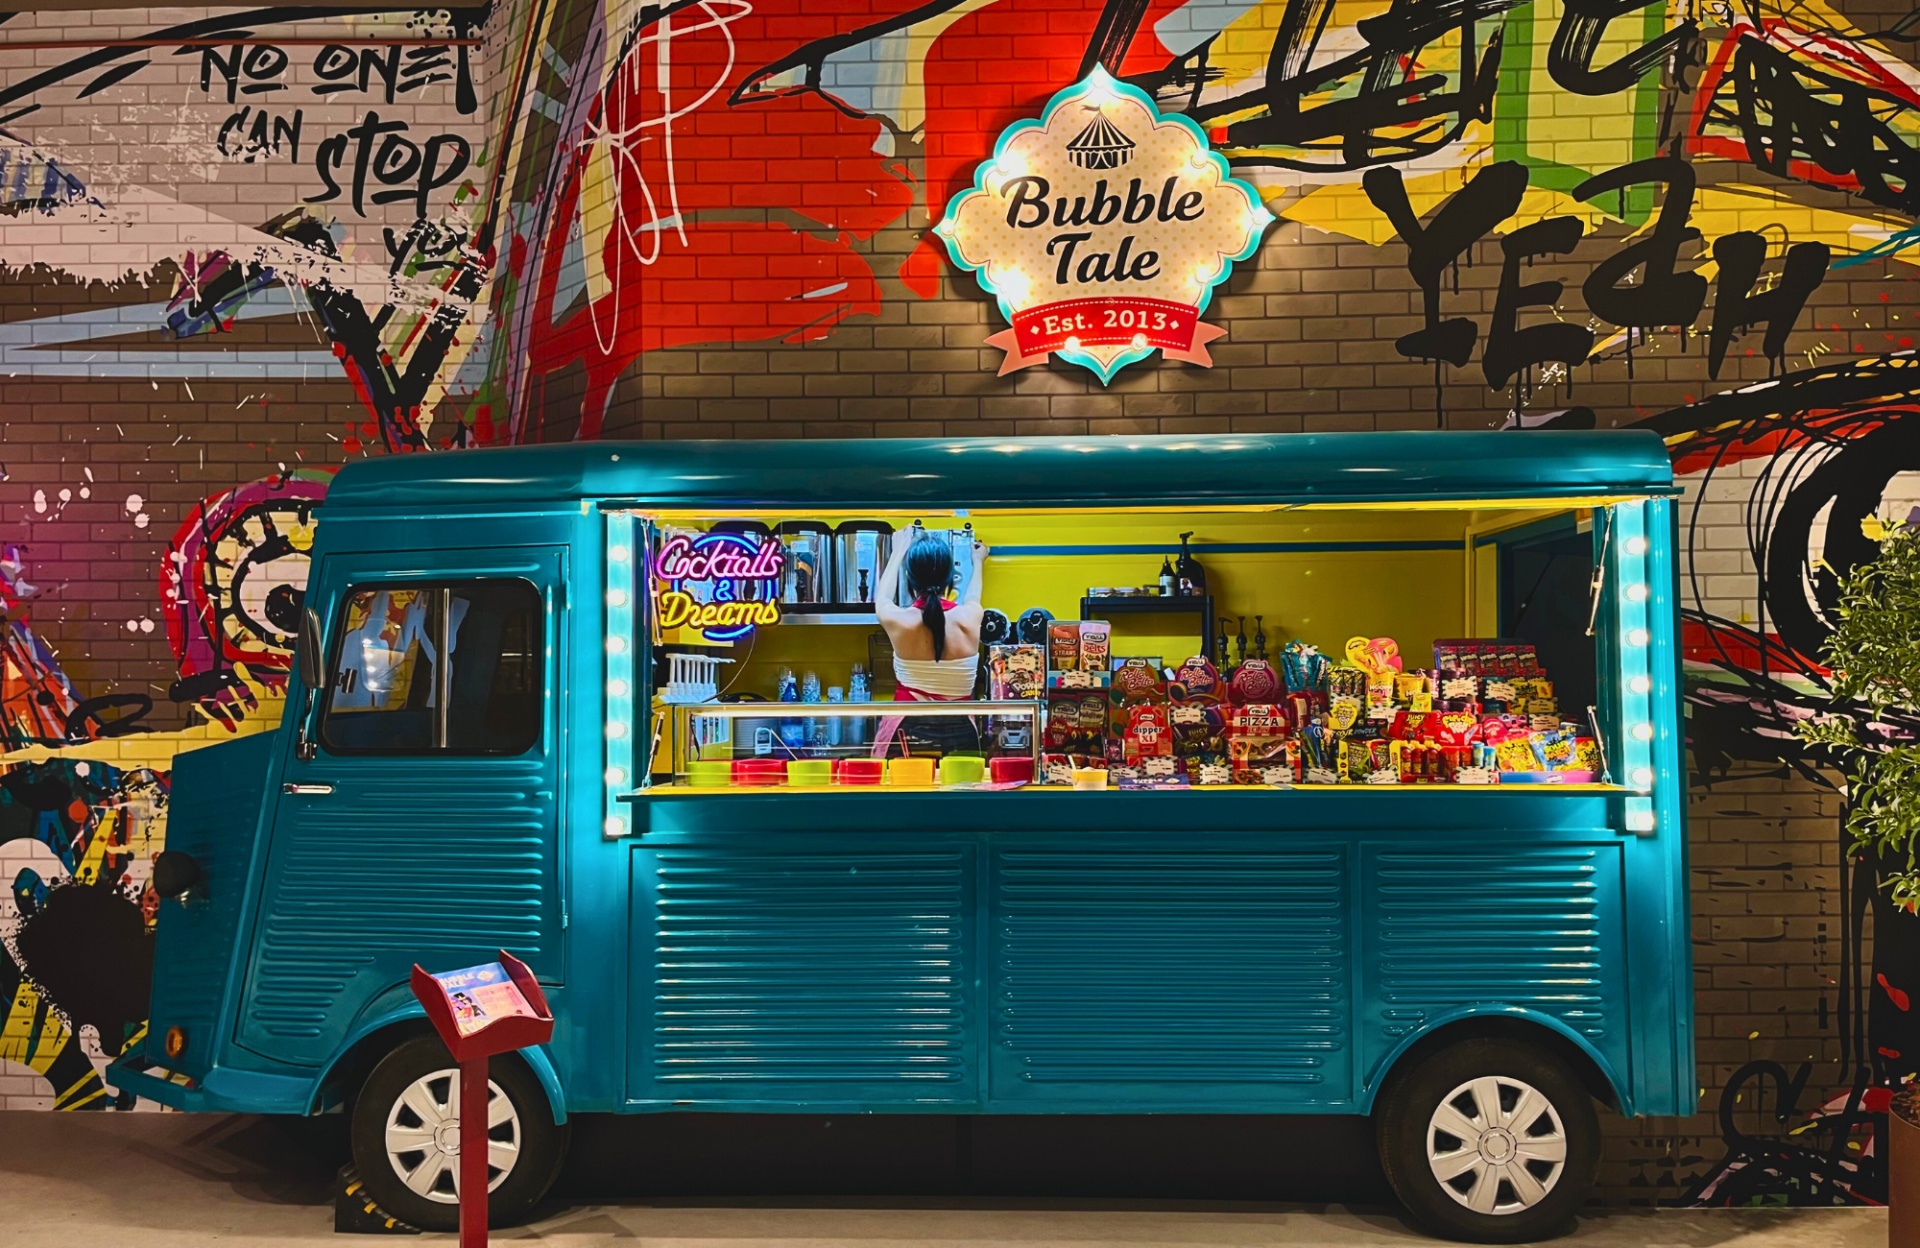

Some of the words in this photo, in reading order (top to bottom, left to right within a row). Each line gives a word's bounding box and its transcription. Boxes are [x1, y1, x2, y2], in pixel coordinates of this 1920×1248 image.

[200, 44, 289, 105] NO
[217, 105, 303, 164] CAN
[303, 110, 471, 219] STOP
[1000, 175, 1205, 229] Bubble
[1046, 231, 1161, 285] Tale
[1044, 313, 1094, 336] Est.
[1103, 309, 1167, 332] 2013
[656, 535, 784, 580] Cocktails
[660, 591, 780, 628] Dreams
[714, 578, 735, 601] &
[1133, 726, 1163, 735] dipper
[1240, 717, 1279, 727] PIZZA
